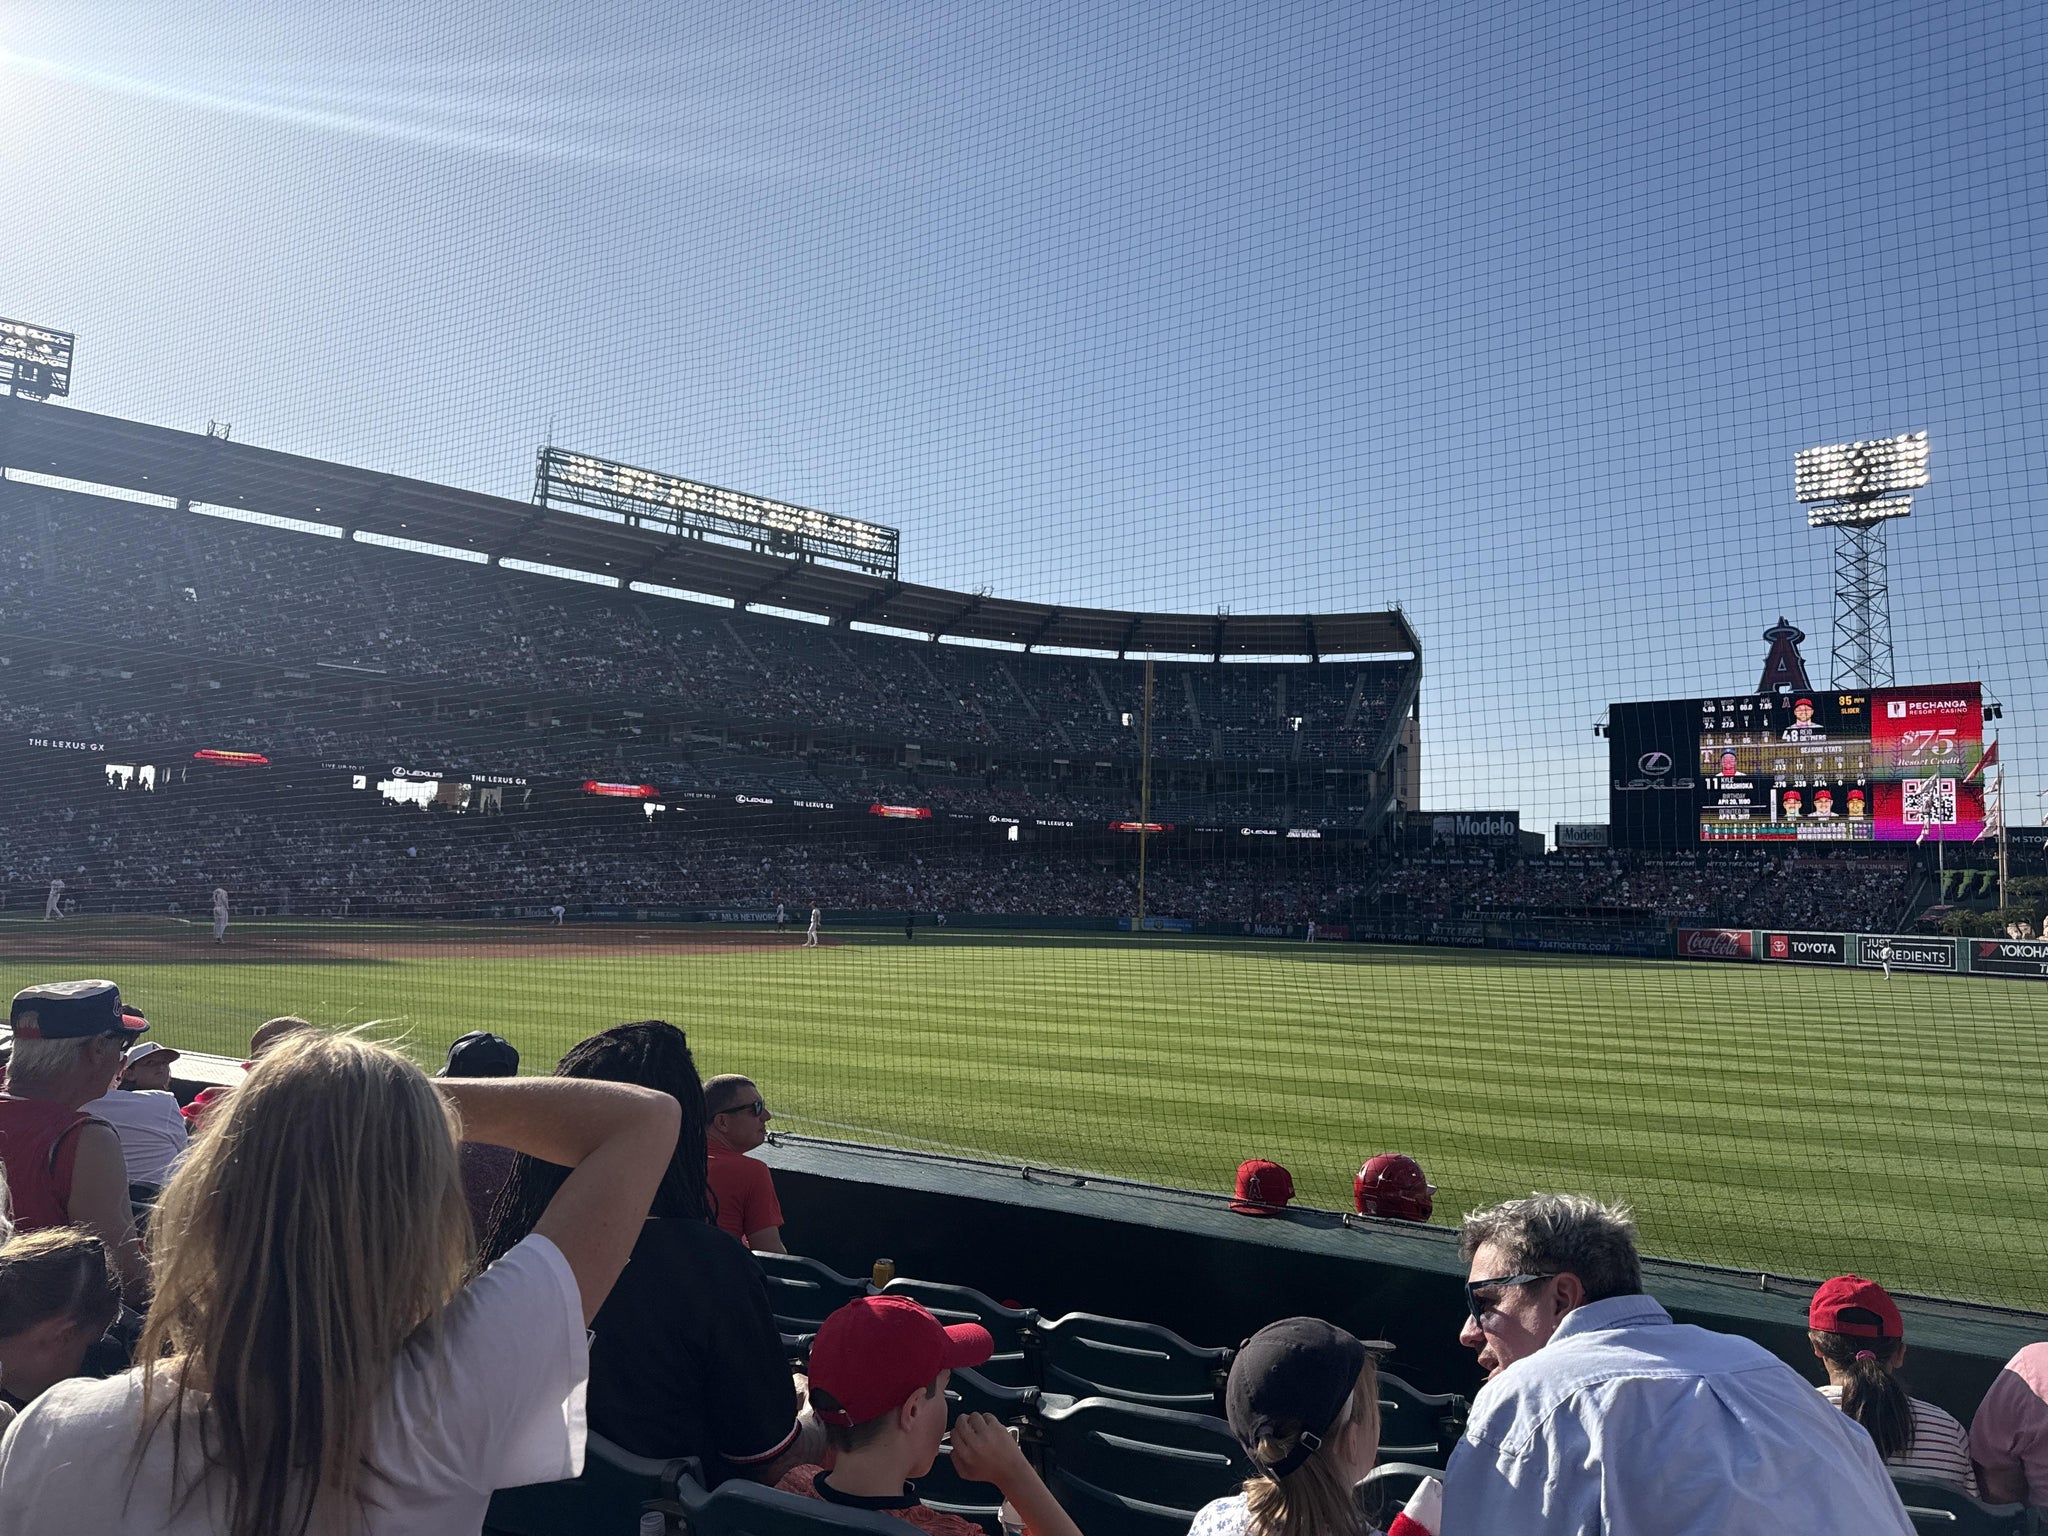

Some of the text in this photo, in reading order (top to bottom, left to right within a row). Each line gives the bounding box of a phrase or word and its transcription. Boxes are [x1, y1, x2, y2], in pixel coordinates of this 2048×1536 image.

[1910, 700, 1967, 710] PECHANGA
[1782, 730, 1799, 742] 48
[52, 741, 86, 749] LEXUS
[1901, 729, 1957, 756] $75
[1930, 757, 1960, 765] Credit
[406, 770, 444, 778] LEXUS
[489, 776, 513, 784] LEXUS
[1614, 778, 1695, 790] LEXUS
[1705, 778, 1718, 790] 11
[1456, 815, 1515, 836] Modelo
[1565, 828, 1603, 842] Modelo
[722, 913, 738, 921] MLB
[1254, 922, 1282, 936] Modelo
[1539, 942, 1611, 951] 714TICKETS.COM
[1688, 931, 1741, 955] Coca-Cola
[1867, 939, 1891, 948] JUST
[1792, 944, 1836, 954] TOYOTA
